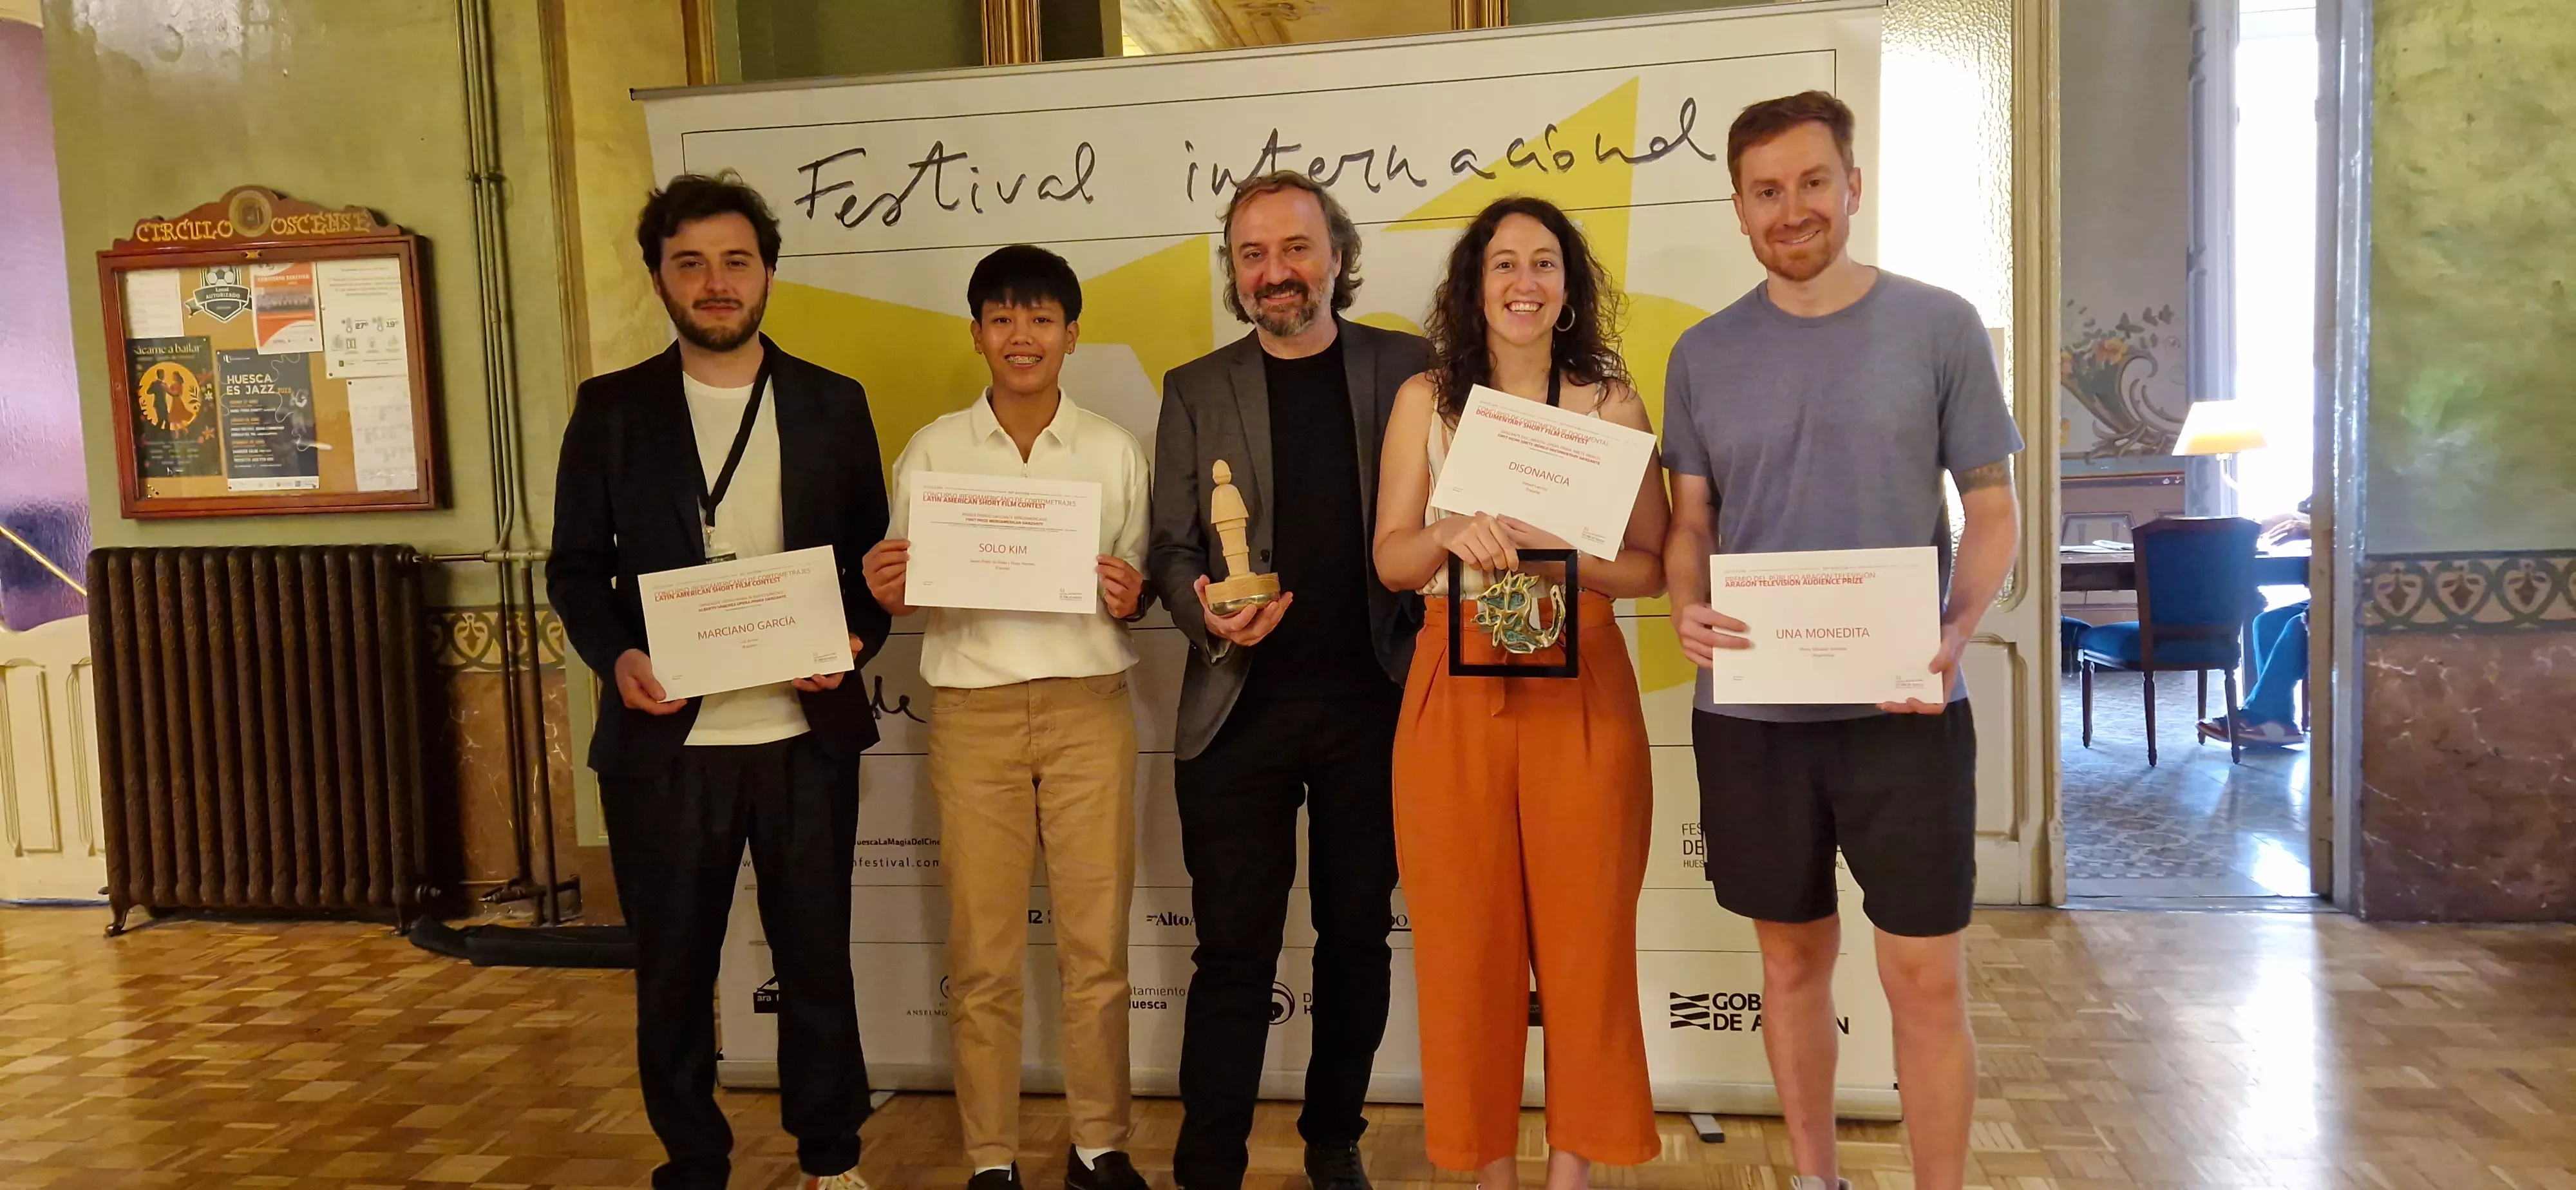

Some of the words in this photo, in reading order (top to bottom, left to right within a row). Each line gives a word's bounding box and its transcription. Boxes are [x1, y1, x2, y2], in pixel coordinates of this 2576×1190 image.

[795, 140, 1095, 228] Festival
[137, 218, 233, 242] CIRCULO
[271, 211, 370, 235] OSCENSE
[227, 373, 272, 384] HUESCA
[226, 385, 240, 395] ES
[245, 384, 275, 395] JAZZ
[1475, 408, 1523, 426] DOCUMENTARY
[1523, 423, 1544, 433] SHORT
[1545, 428, 1559, 437] FILM
[1560, 433, 1588, 445] CONTEST
[1509, 462, 1570, 486] DISONANCIA
[979, 543, 1006, 554] SOLO
[1009, 545, 1027, 554] KIM
[655, 594, 674, 602] LATIN
[676, 589, 711, 599] AMERICAN
[712, 584, 734, 593] SHORT
[752, 577, 781, 586] CONTEST
[697, 623, 754, 640] MARCIANO
[757, 616, 796, 630] GARCÍA
[1776, 628, 1802, 639] UNA
[1806, 627, 1870, 639] MONEDITA
[1131, 986, 1186, 996] tamiento
[1713, 1013, 1743, 1031] DE
